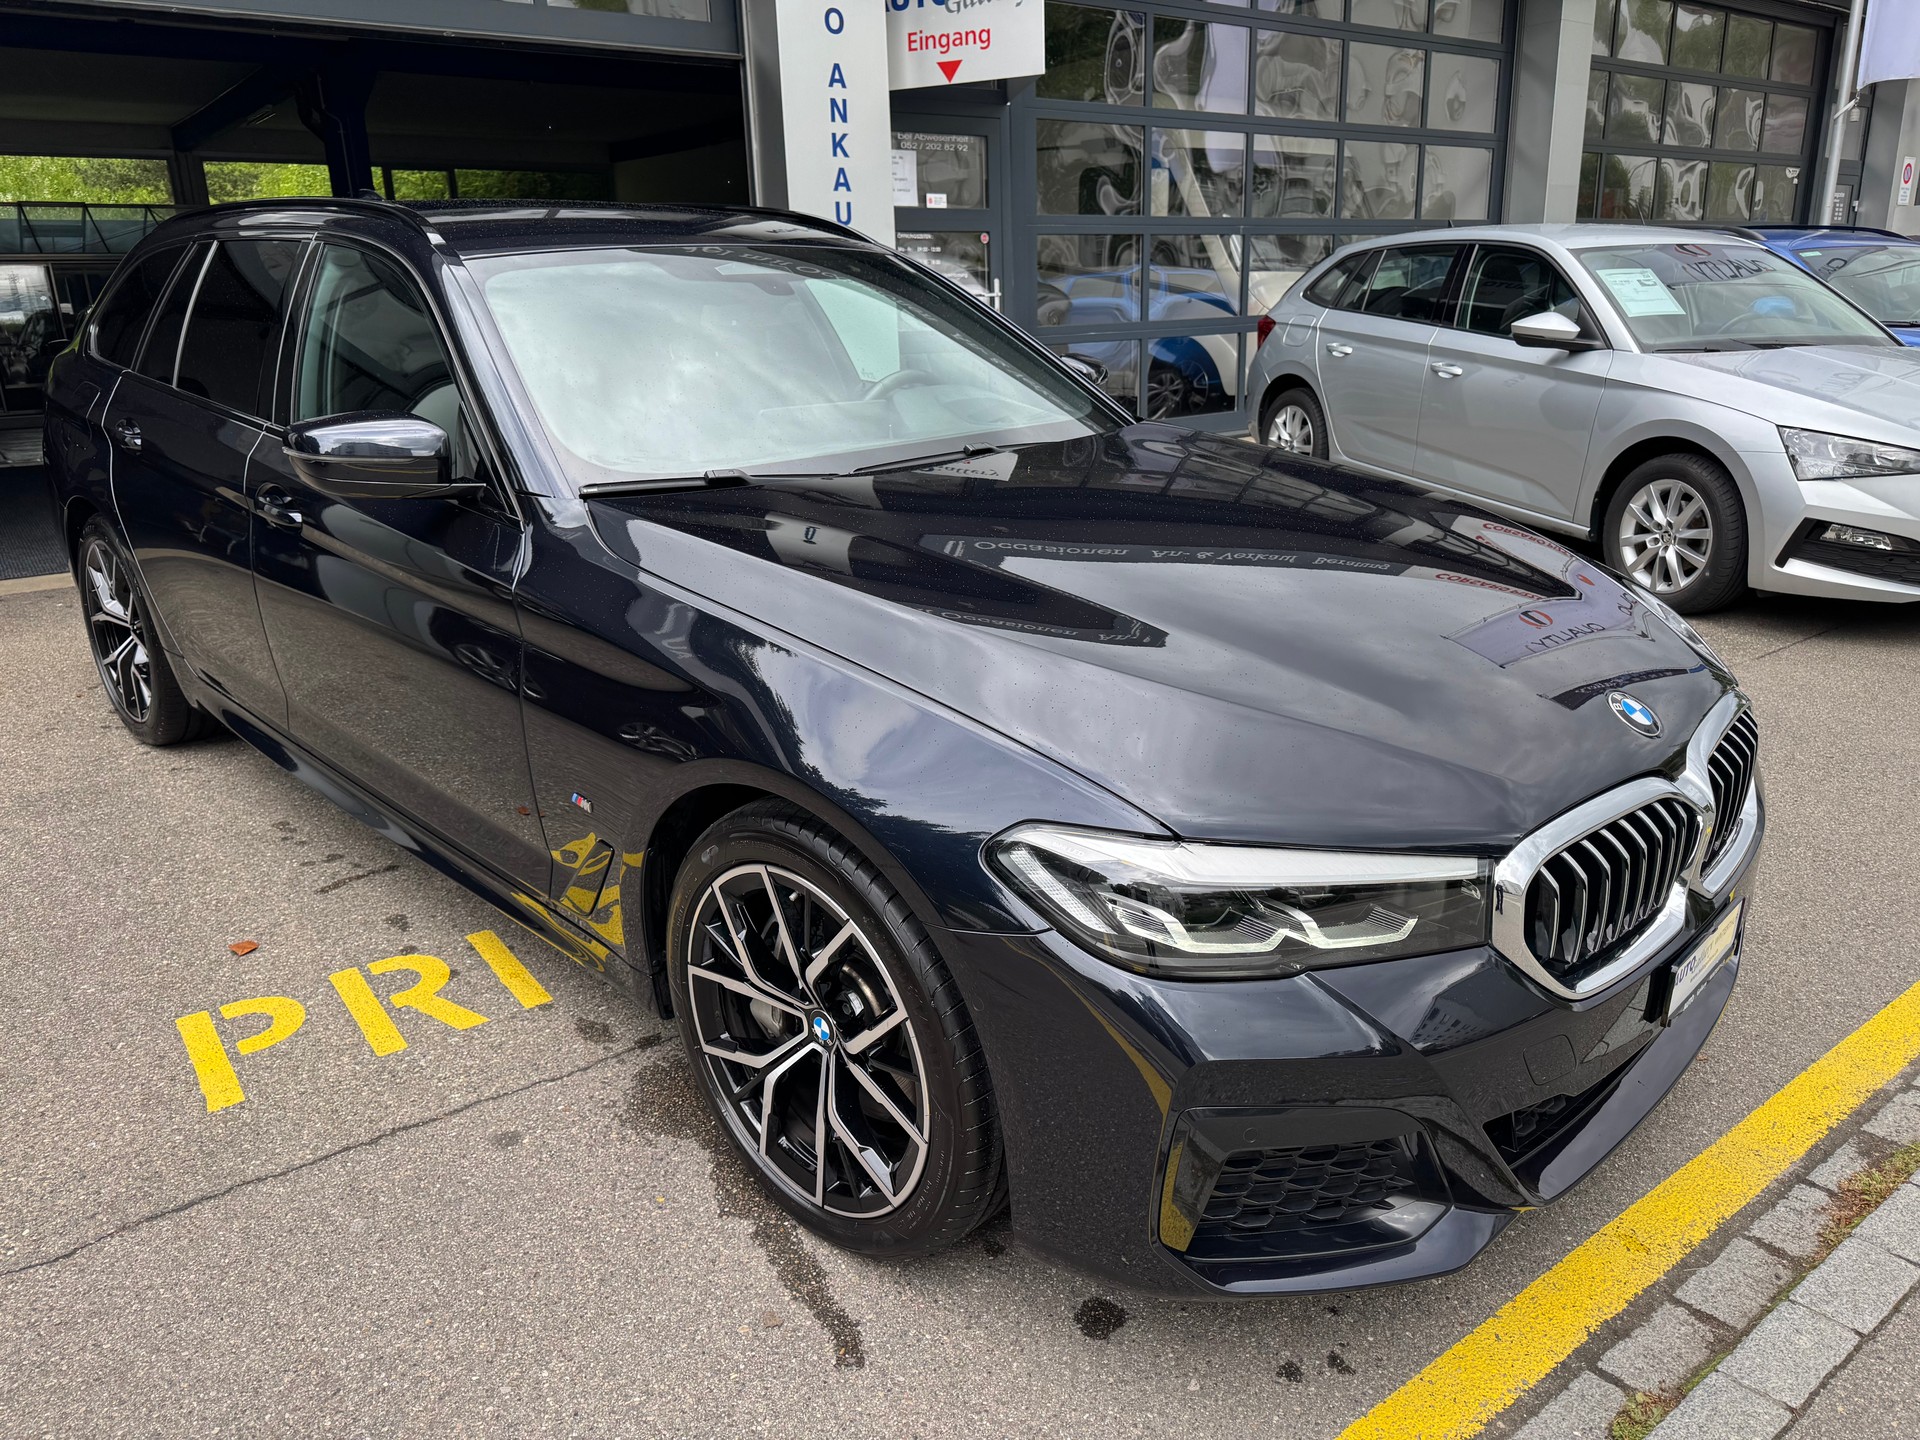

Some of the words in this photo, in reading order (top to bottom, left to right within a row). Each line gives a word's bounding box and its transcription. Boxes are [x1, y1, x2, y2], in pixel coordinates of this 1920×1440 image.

[908, 28, 991, 54] Eingang
[900, 141, 918, 150] 052
[925, 142, 942, 151] 202
[957, 144, 969, 152] 92
[174, 929, 553, 1112] PRI
